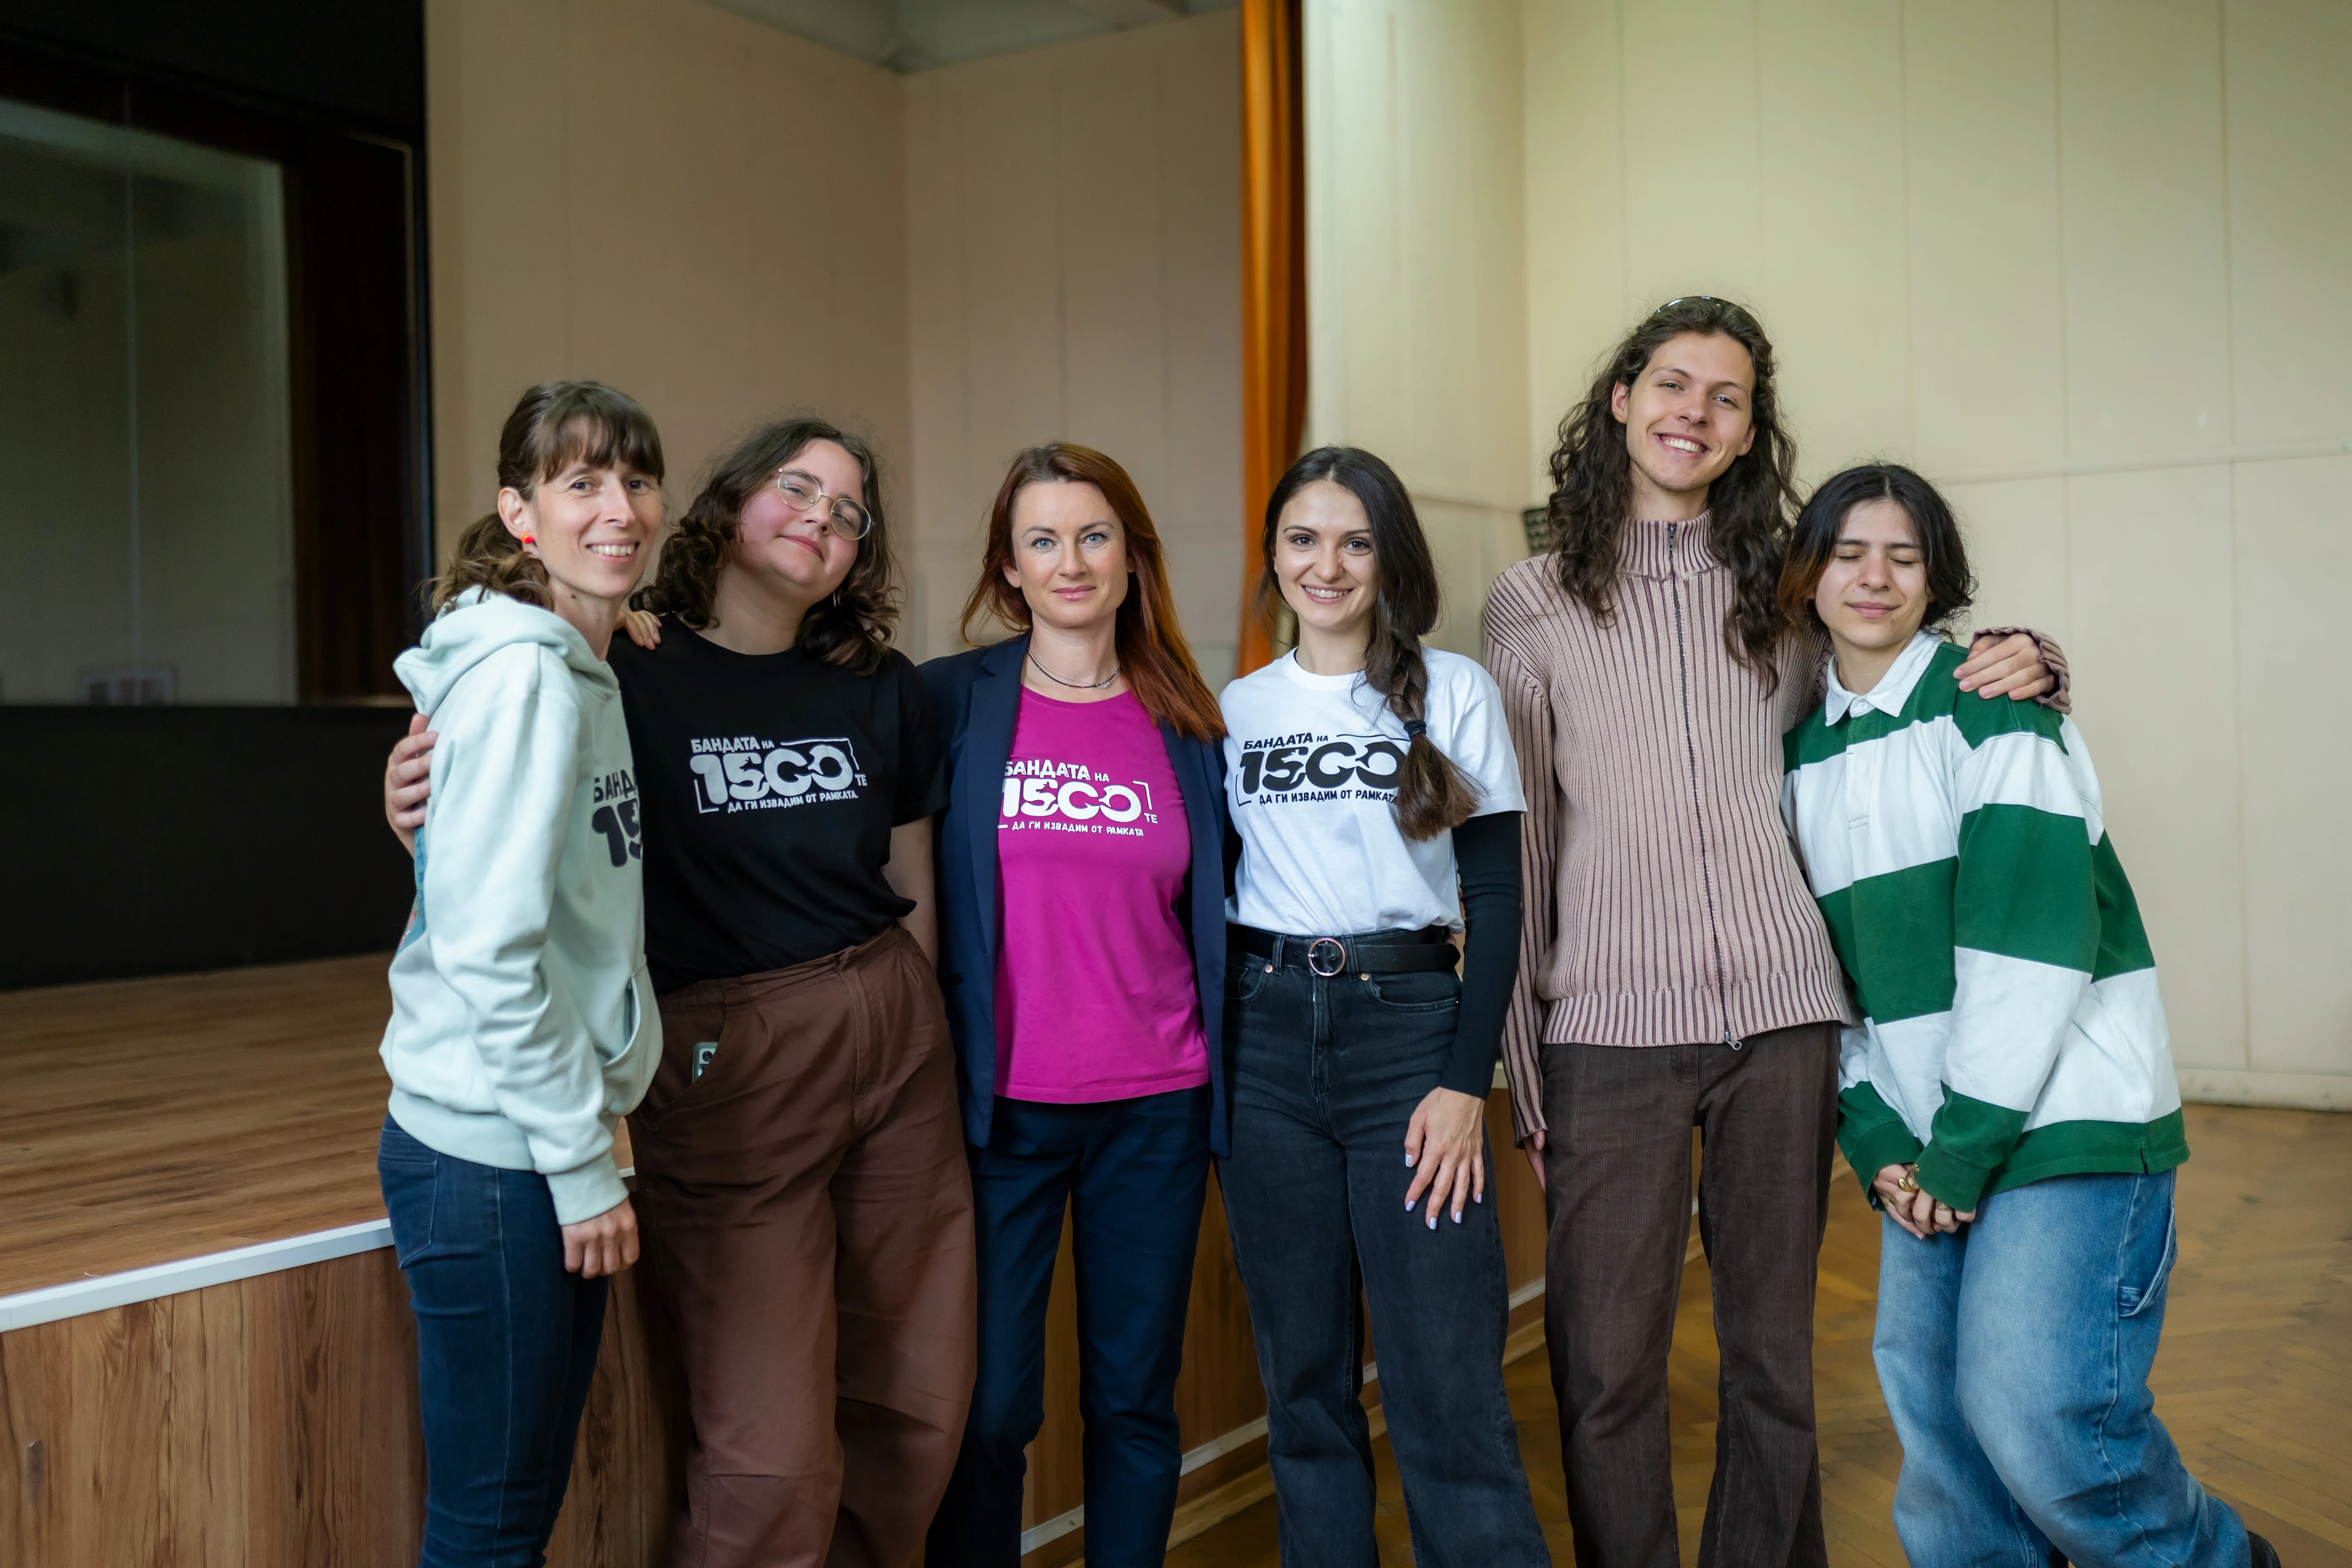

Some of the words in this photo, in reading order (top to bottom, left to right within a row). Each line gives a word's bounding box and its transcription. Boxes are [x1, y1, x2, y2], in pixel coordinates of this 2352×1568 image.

[691, 737, 761, 753] БАНДАТА
[761, 740, 774, 749] НА
[1244, 732, 1313, 750] БАНДАТА
[1004, 760, 1090, 781] БАНДАТА
[1094, 773, 1109, 782] НА
[855, 774, 868, 787] ТЕ
[727, 801, 743, 813] ДА
[745, 800, 757, 810] ГИ
[759, 796, 804, 809] ИЗВАДИМ
[806, 794, 817, 803] ОТ
[820, 790, 858, 802] РАМКАТА.
[1259, 794, 1272, 805] ДА
[1276, 793, 1288, 803] ГИ
[1291, 791, 1337, 804] ИЗВАДИМ
[1340, 790, 1352, 800] ОТ
[1144, 812, 1158, 824] ТЕ
[1012, 822, 1025, 830] ДА
[1044, 822, 1088, 833] ИЗВАДИМ
[1091, 825, 1102, 834] ОТ
[1107, 826, 1144, 836] РАМКАТА
